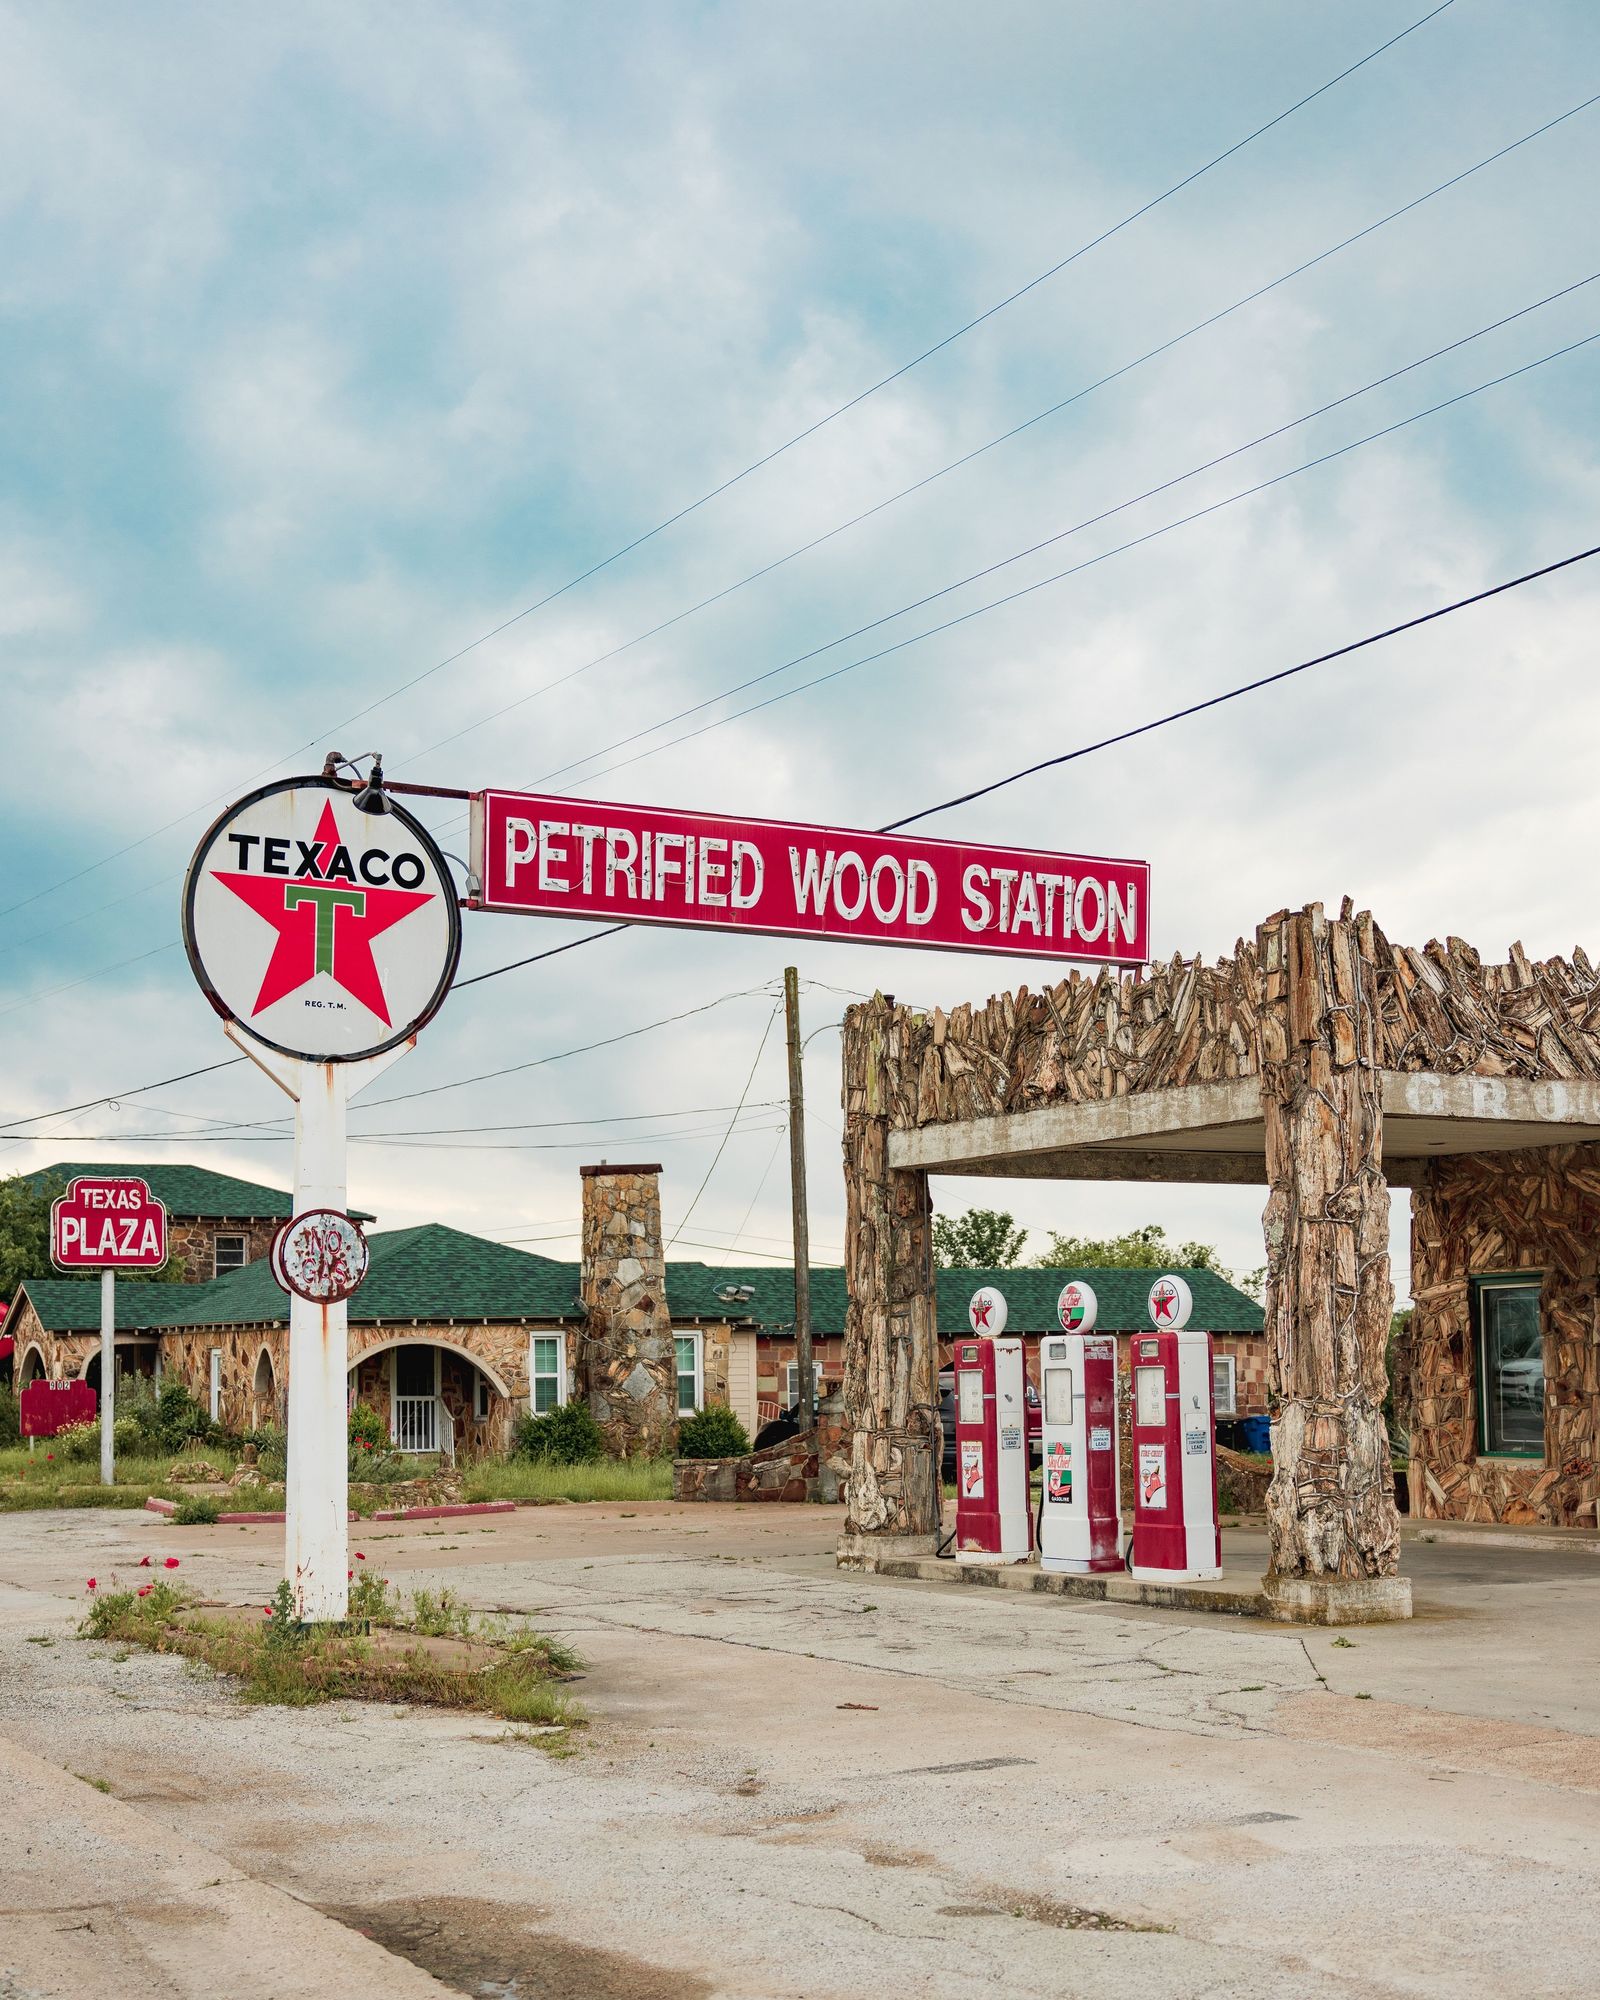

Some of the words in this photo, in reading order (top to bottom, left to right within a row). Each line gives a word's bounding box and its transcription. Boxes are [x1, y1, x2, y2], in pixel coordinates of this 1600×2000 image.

[228, 833, 426, 890] TEXACO
[504, 816, 764, 909] PETRIFIED
[787, 845, 938, 926] WOOD
[961, 863, 1138, 945] STATION
[285, 884, 366, 979] T
[304, 1000, 326, 1009] REG.
[1405, 1072, 1600, 1122] GRO
[80, 1188, 142, 1210] TEXAS
[61, 1217, 160, 1257] PLAZA
[311, 1226, 343, 1256] NO
[301, 1257, 348, 1286] GAS
[50, 1380, 70, 1390] 902
